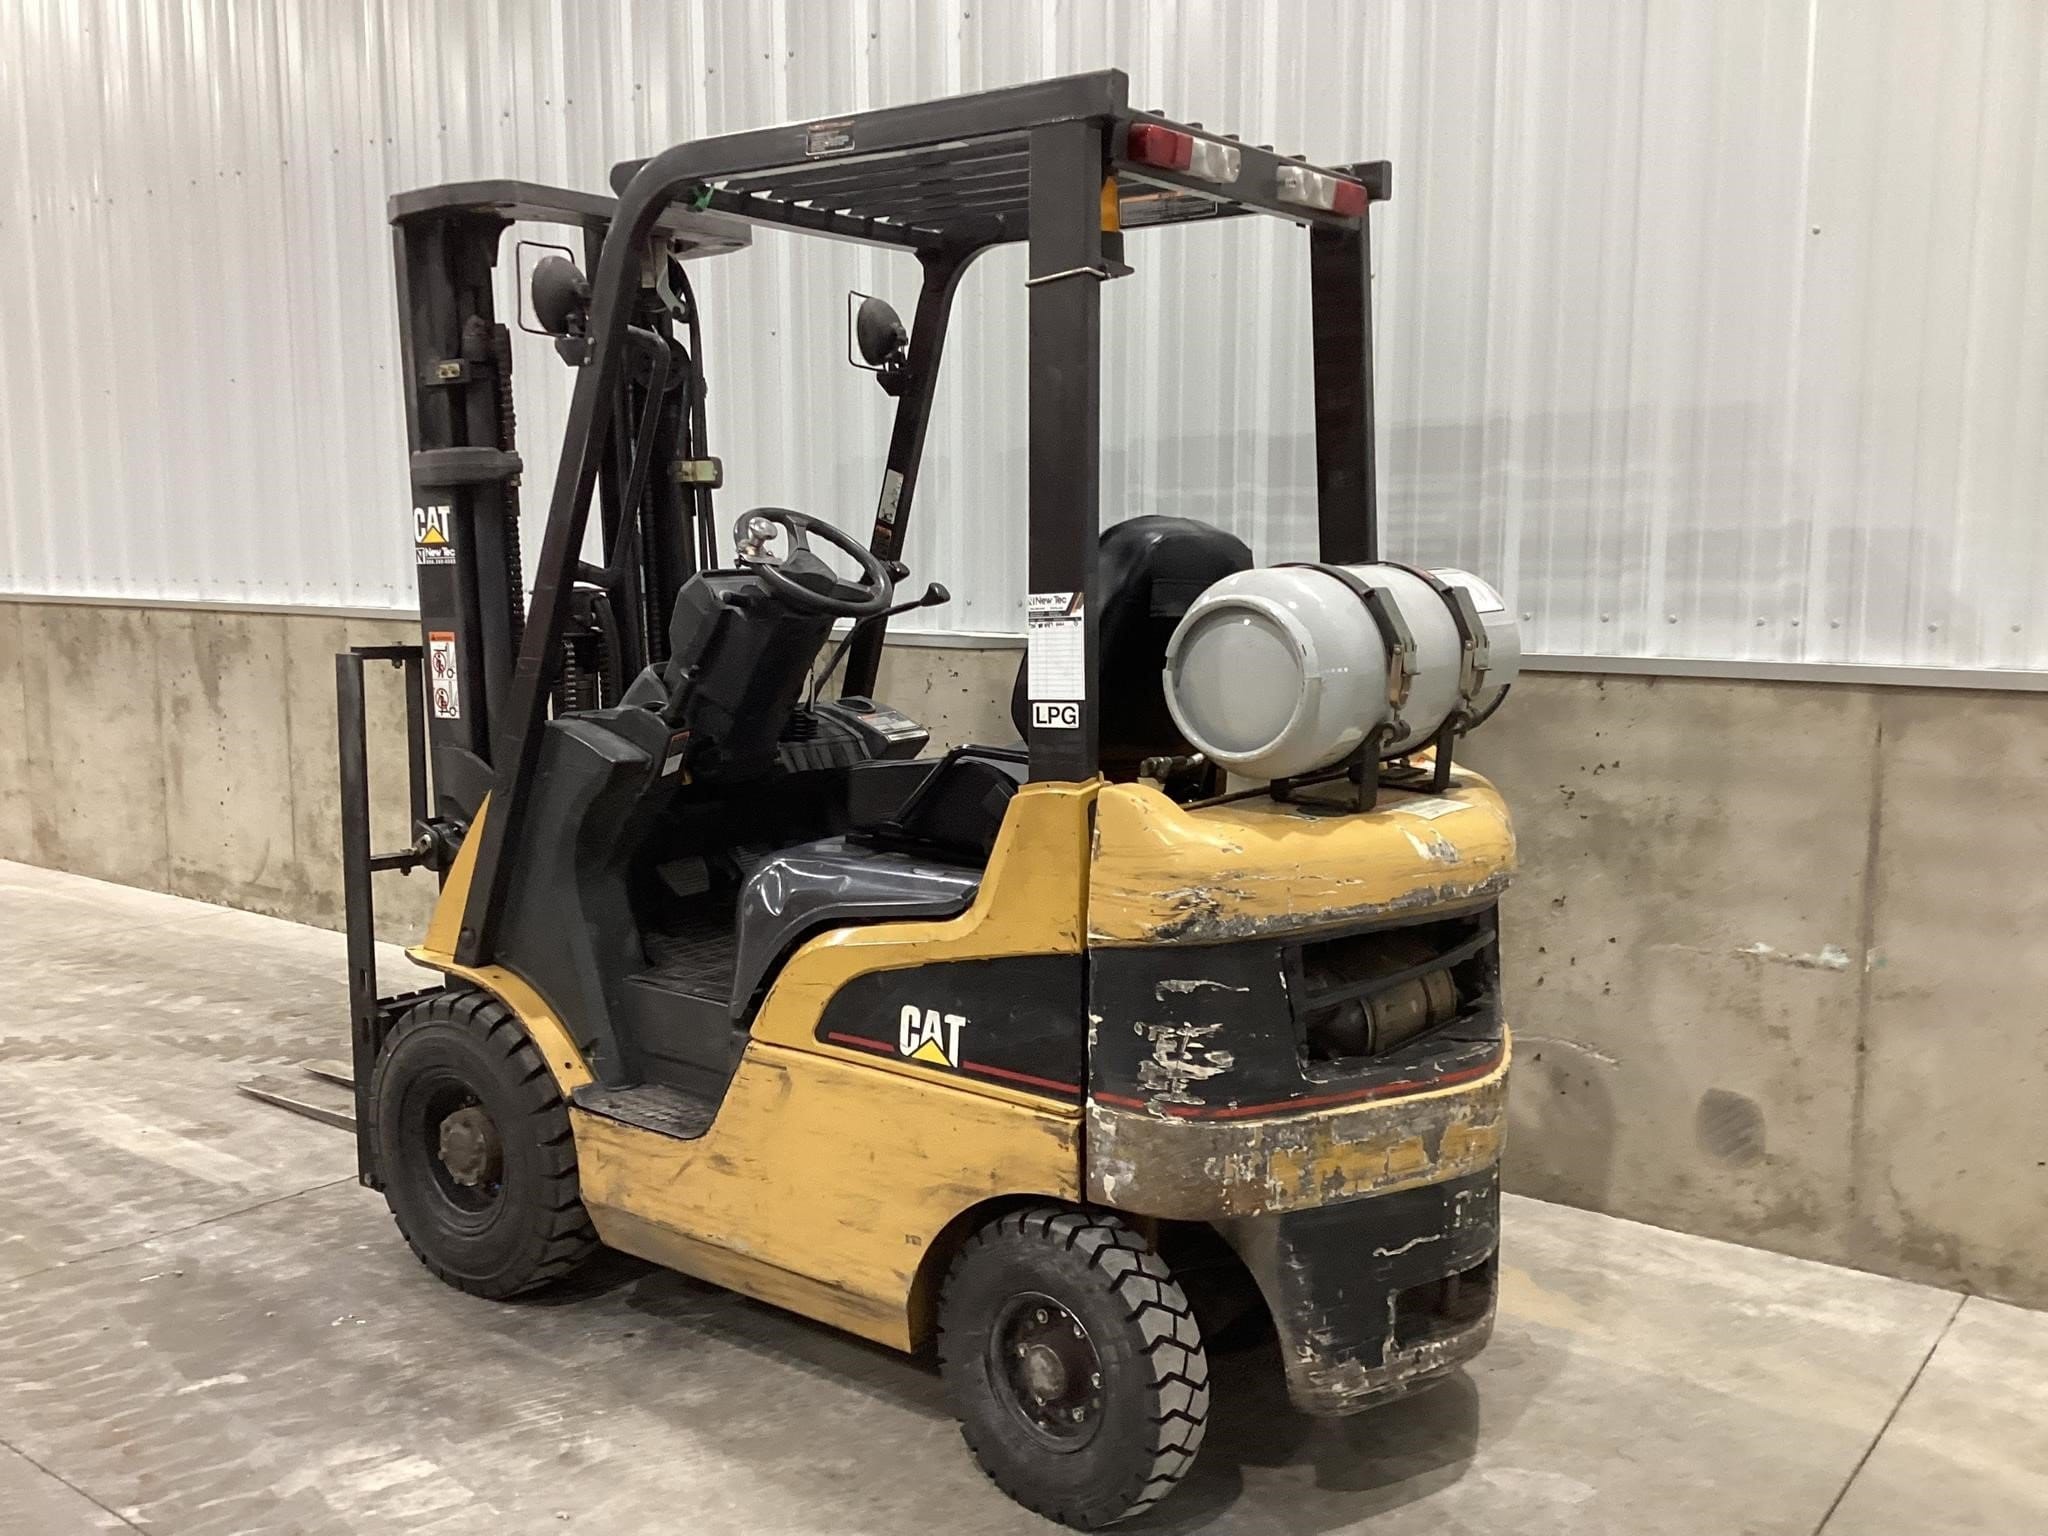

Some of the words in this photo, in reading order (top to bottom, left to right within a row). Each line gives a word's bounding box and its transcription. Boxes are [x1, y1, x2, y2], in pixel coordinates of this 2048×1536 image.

[413, 506, 450, 543] CAT
[1036, 596, 1053, 605] New
[1053, 595, 1067, 604] Tec
[1036, 706, 1077, 725] LPG
[900, 1004, 967, 1069] CAT
